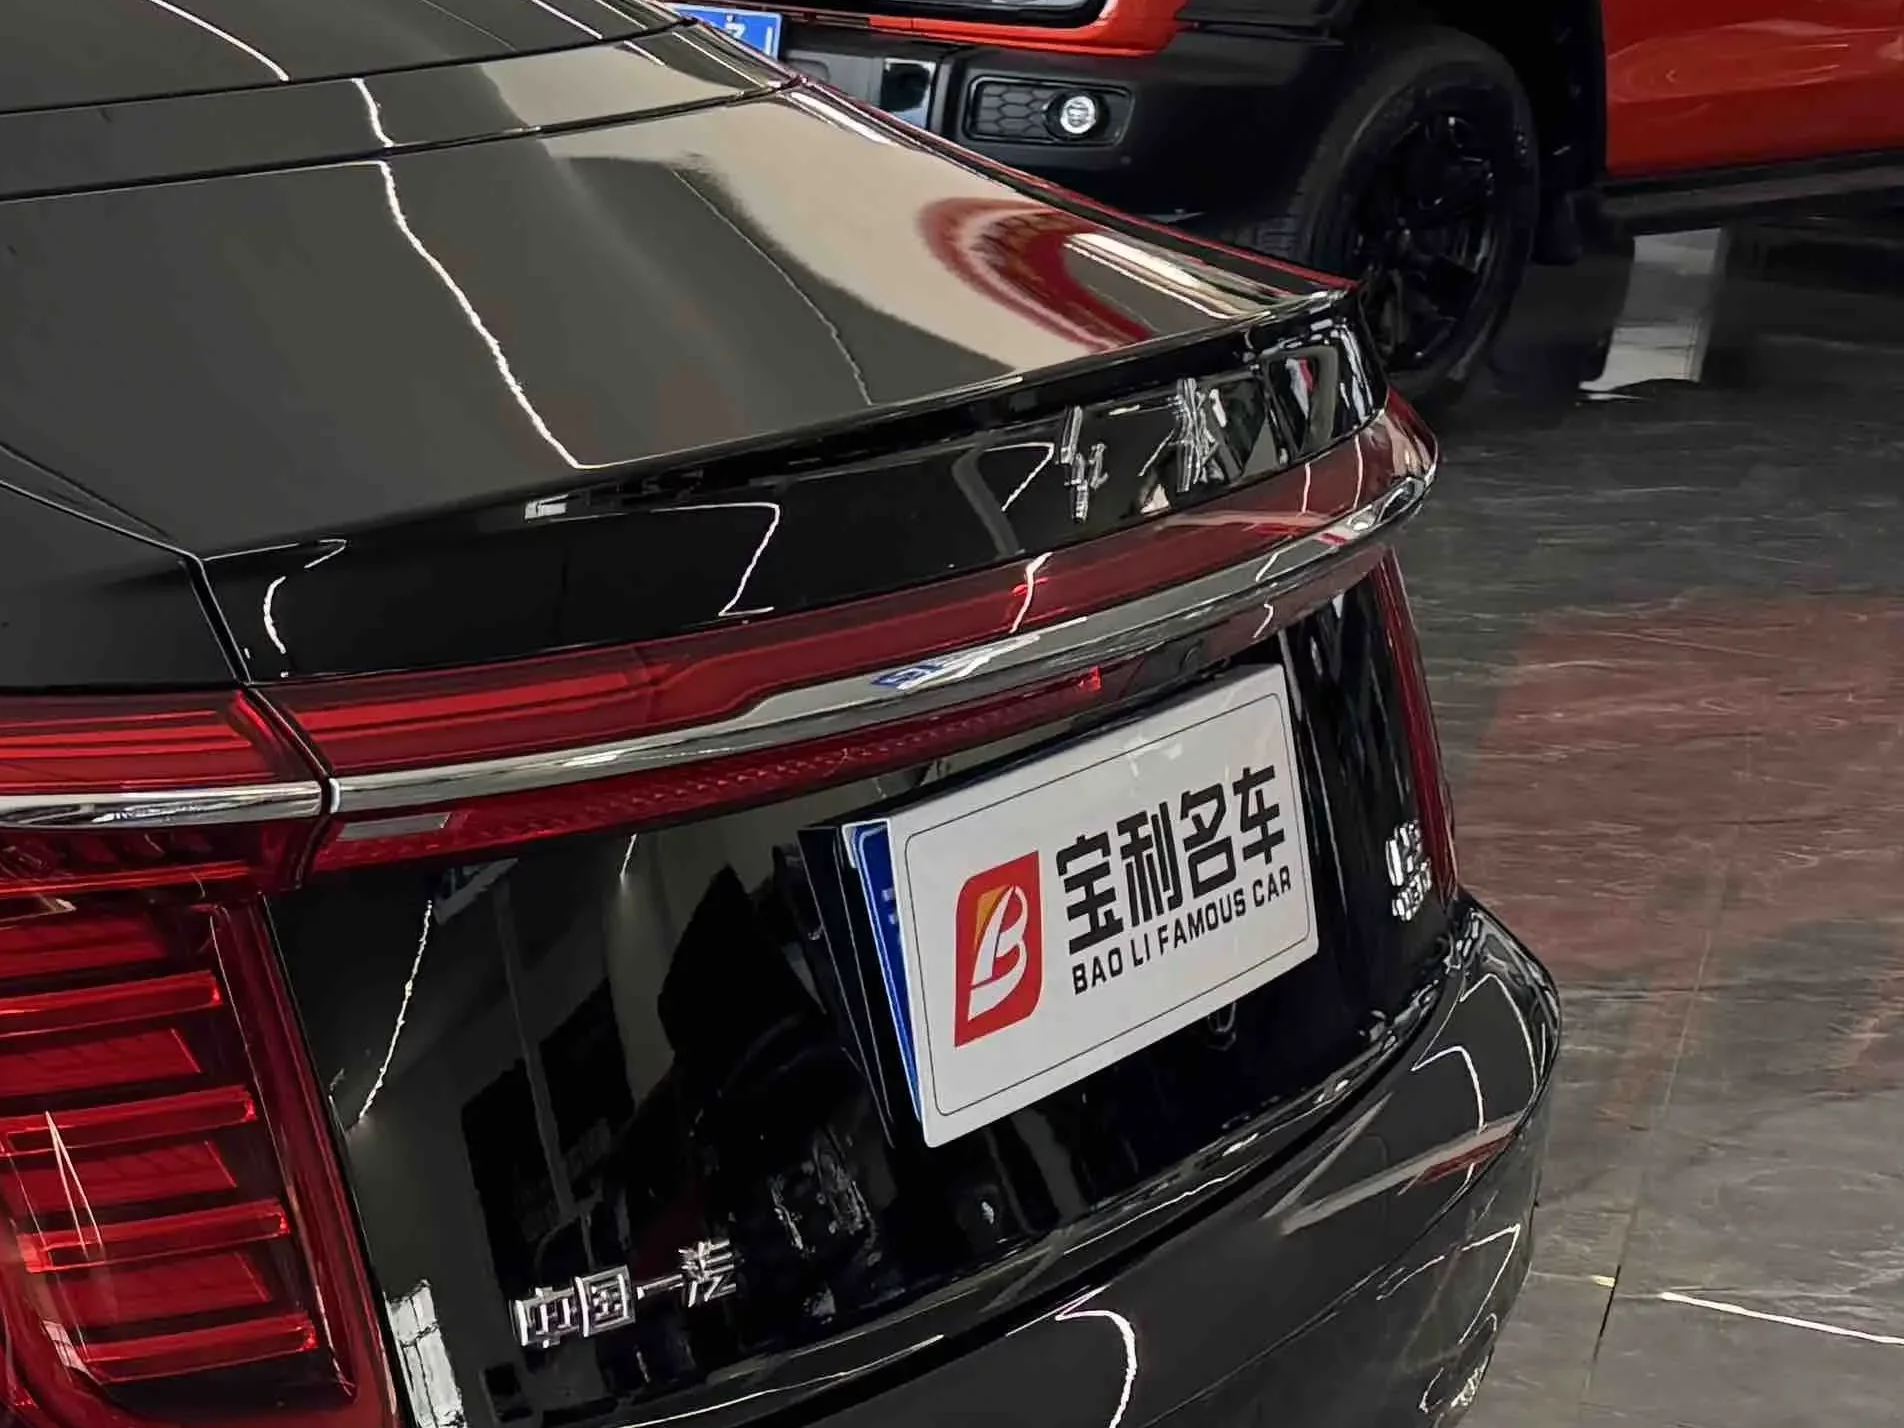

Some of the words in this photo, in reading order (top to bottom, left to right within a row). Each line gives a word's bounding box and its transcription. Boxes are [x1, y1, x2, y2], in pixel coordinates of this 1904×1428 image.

[1056, 765, 1286, 955] 宝利名车
[1072, 946, 1125, 996] BAO
[1130, 931, 1152, 969] LI
[1158, 888, 1248, 954] FAMOUS
[1253, 865, 1292, 910] CAR
[512, 1238, 738, 1348] 中国一汽
